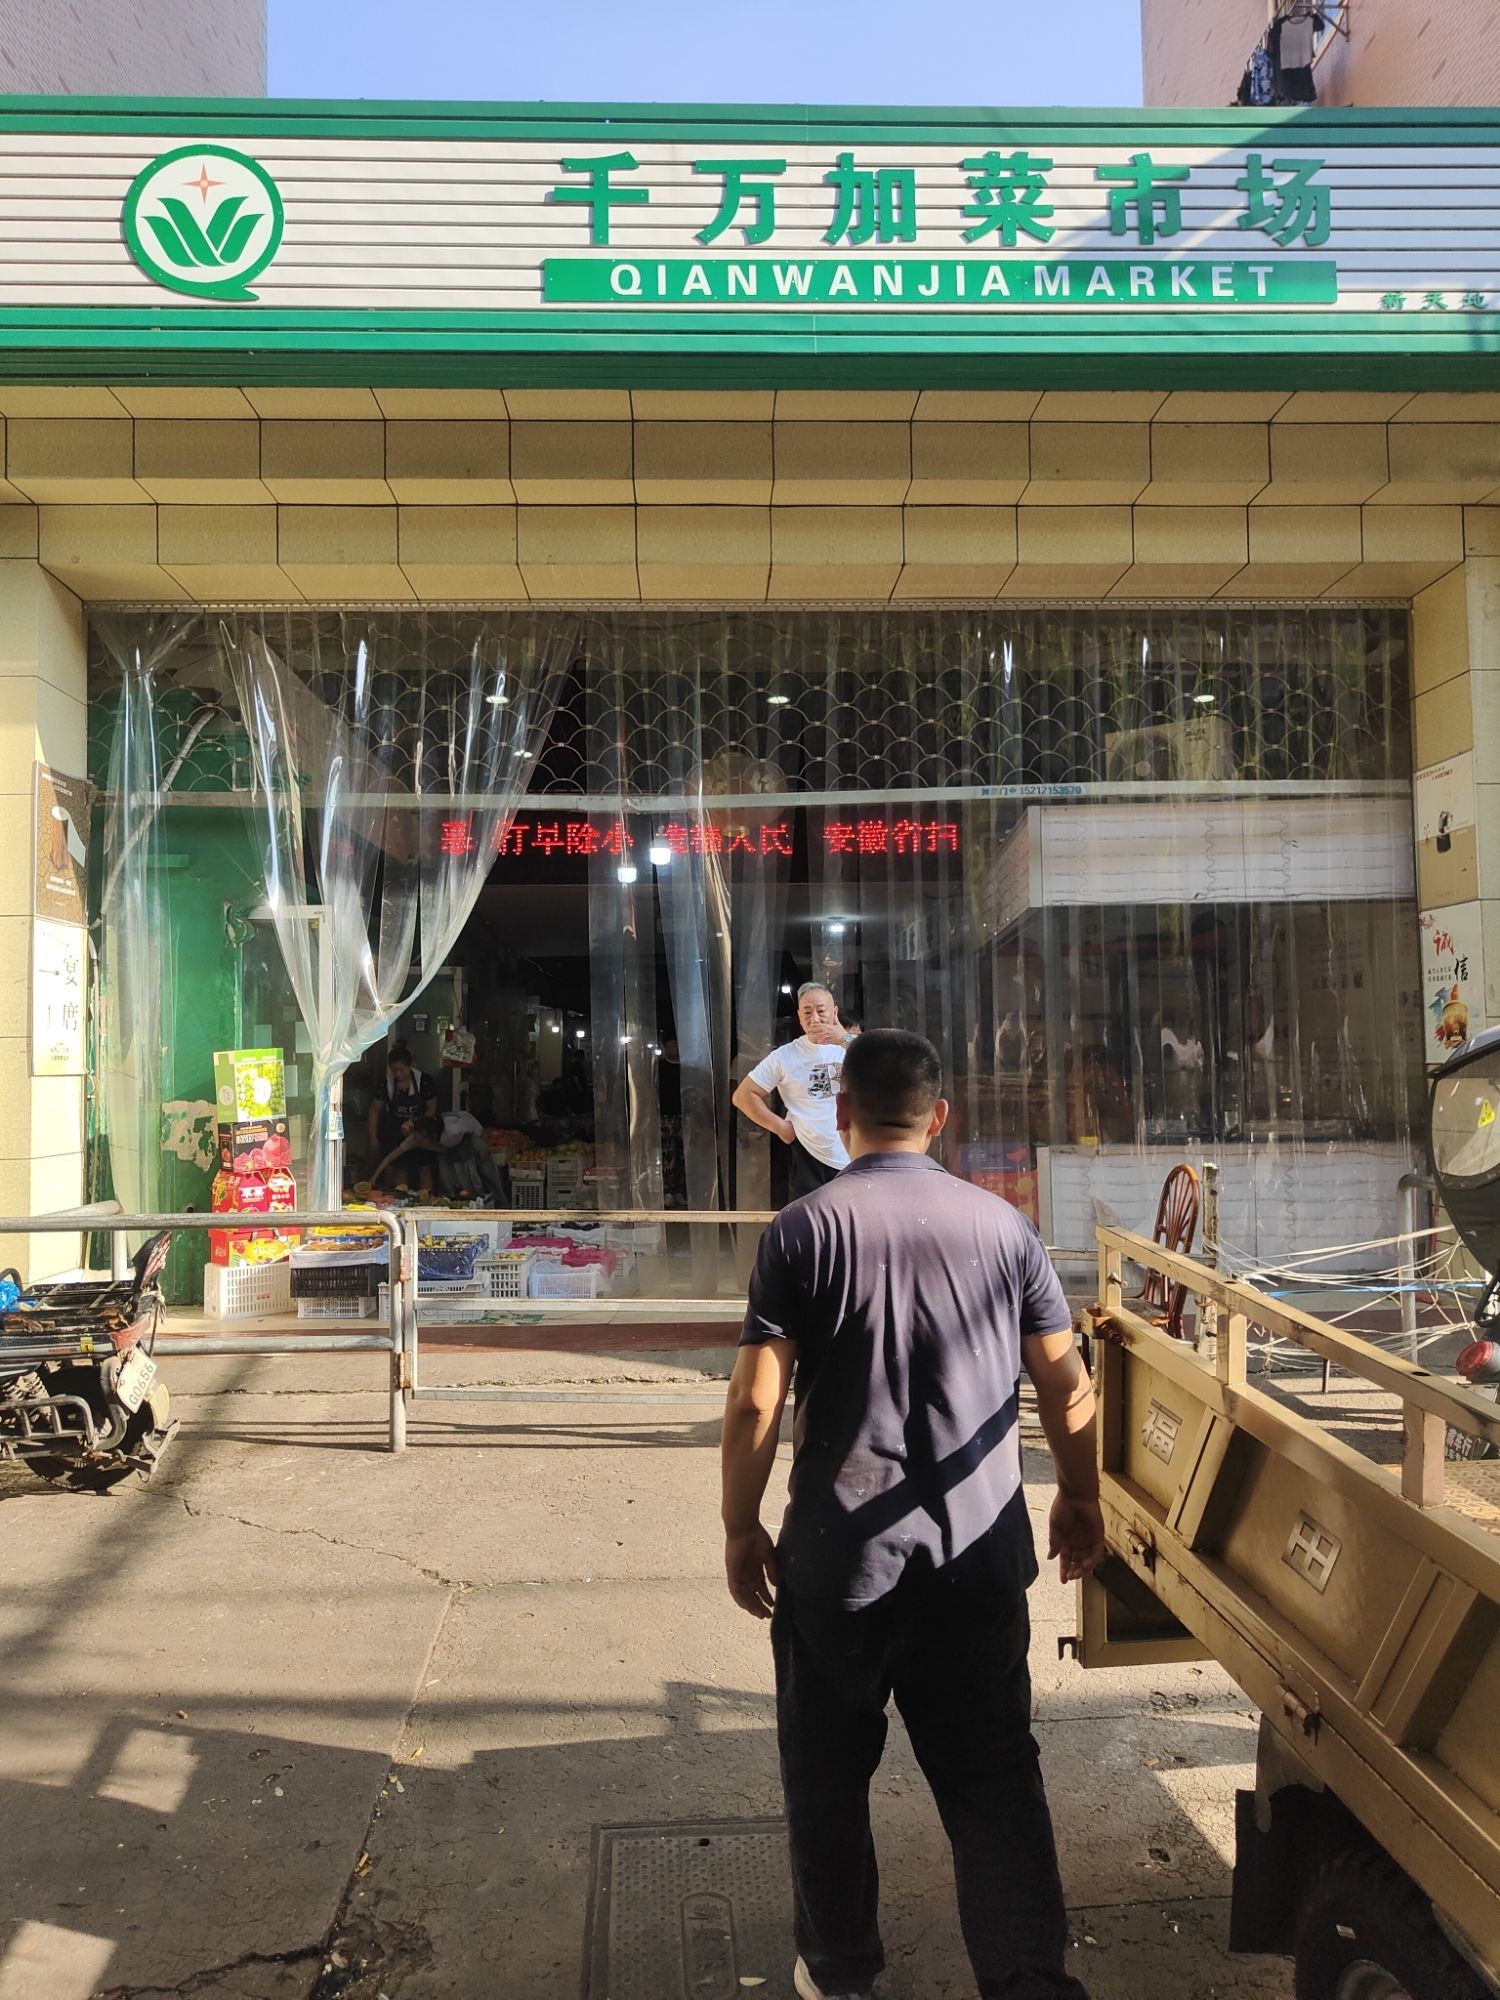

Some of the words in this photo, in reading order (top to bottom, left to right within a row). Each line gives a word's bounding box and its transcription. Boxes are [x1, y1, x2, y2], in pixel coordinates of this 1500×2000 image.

[553, 150, 1332, 247] 千万加菜市场
[610, 263, 1010, 297] QIANWANJIA
[1033, 264, 1275, 297] MARKET
[1141, 1398, 1183, 1466] 福
[1280, 1508, 1342, 1595] 田
